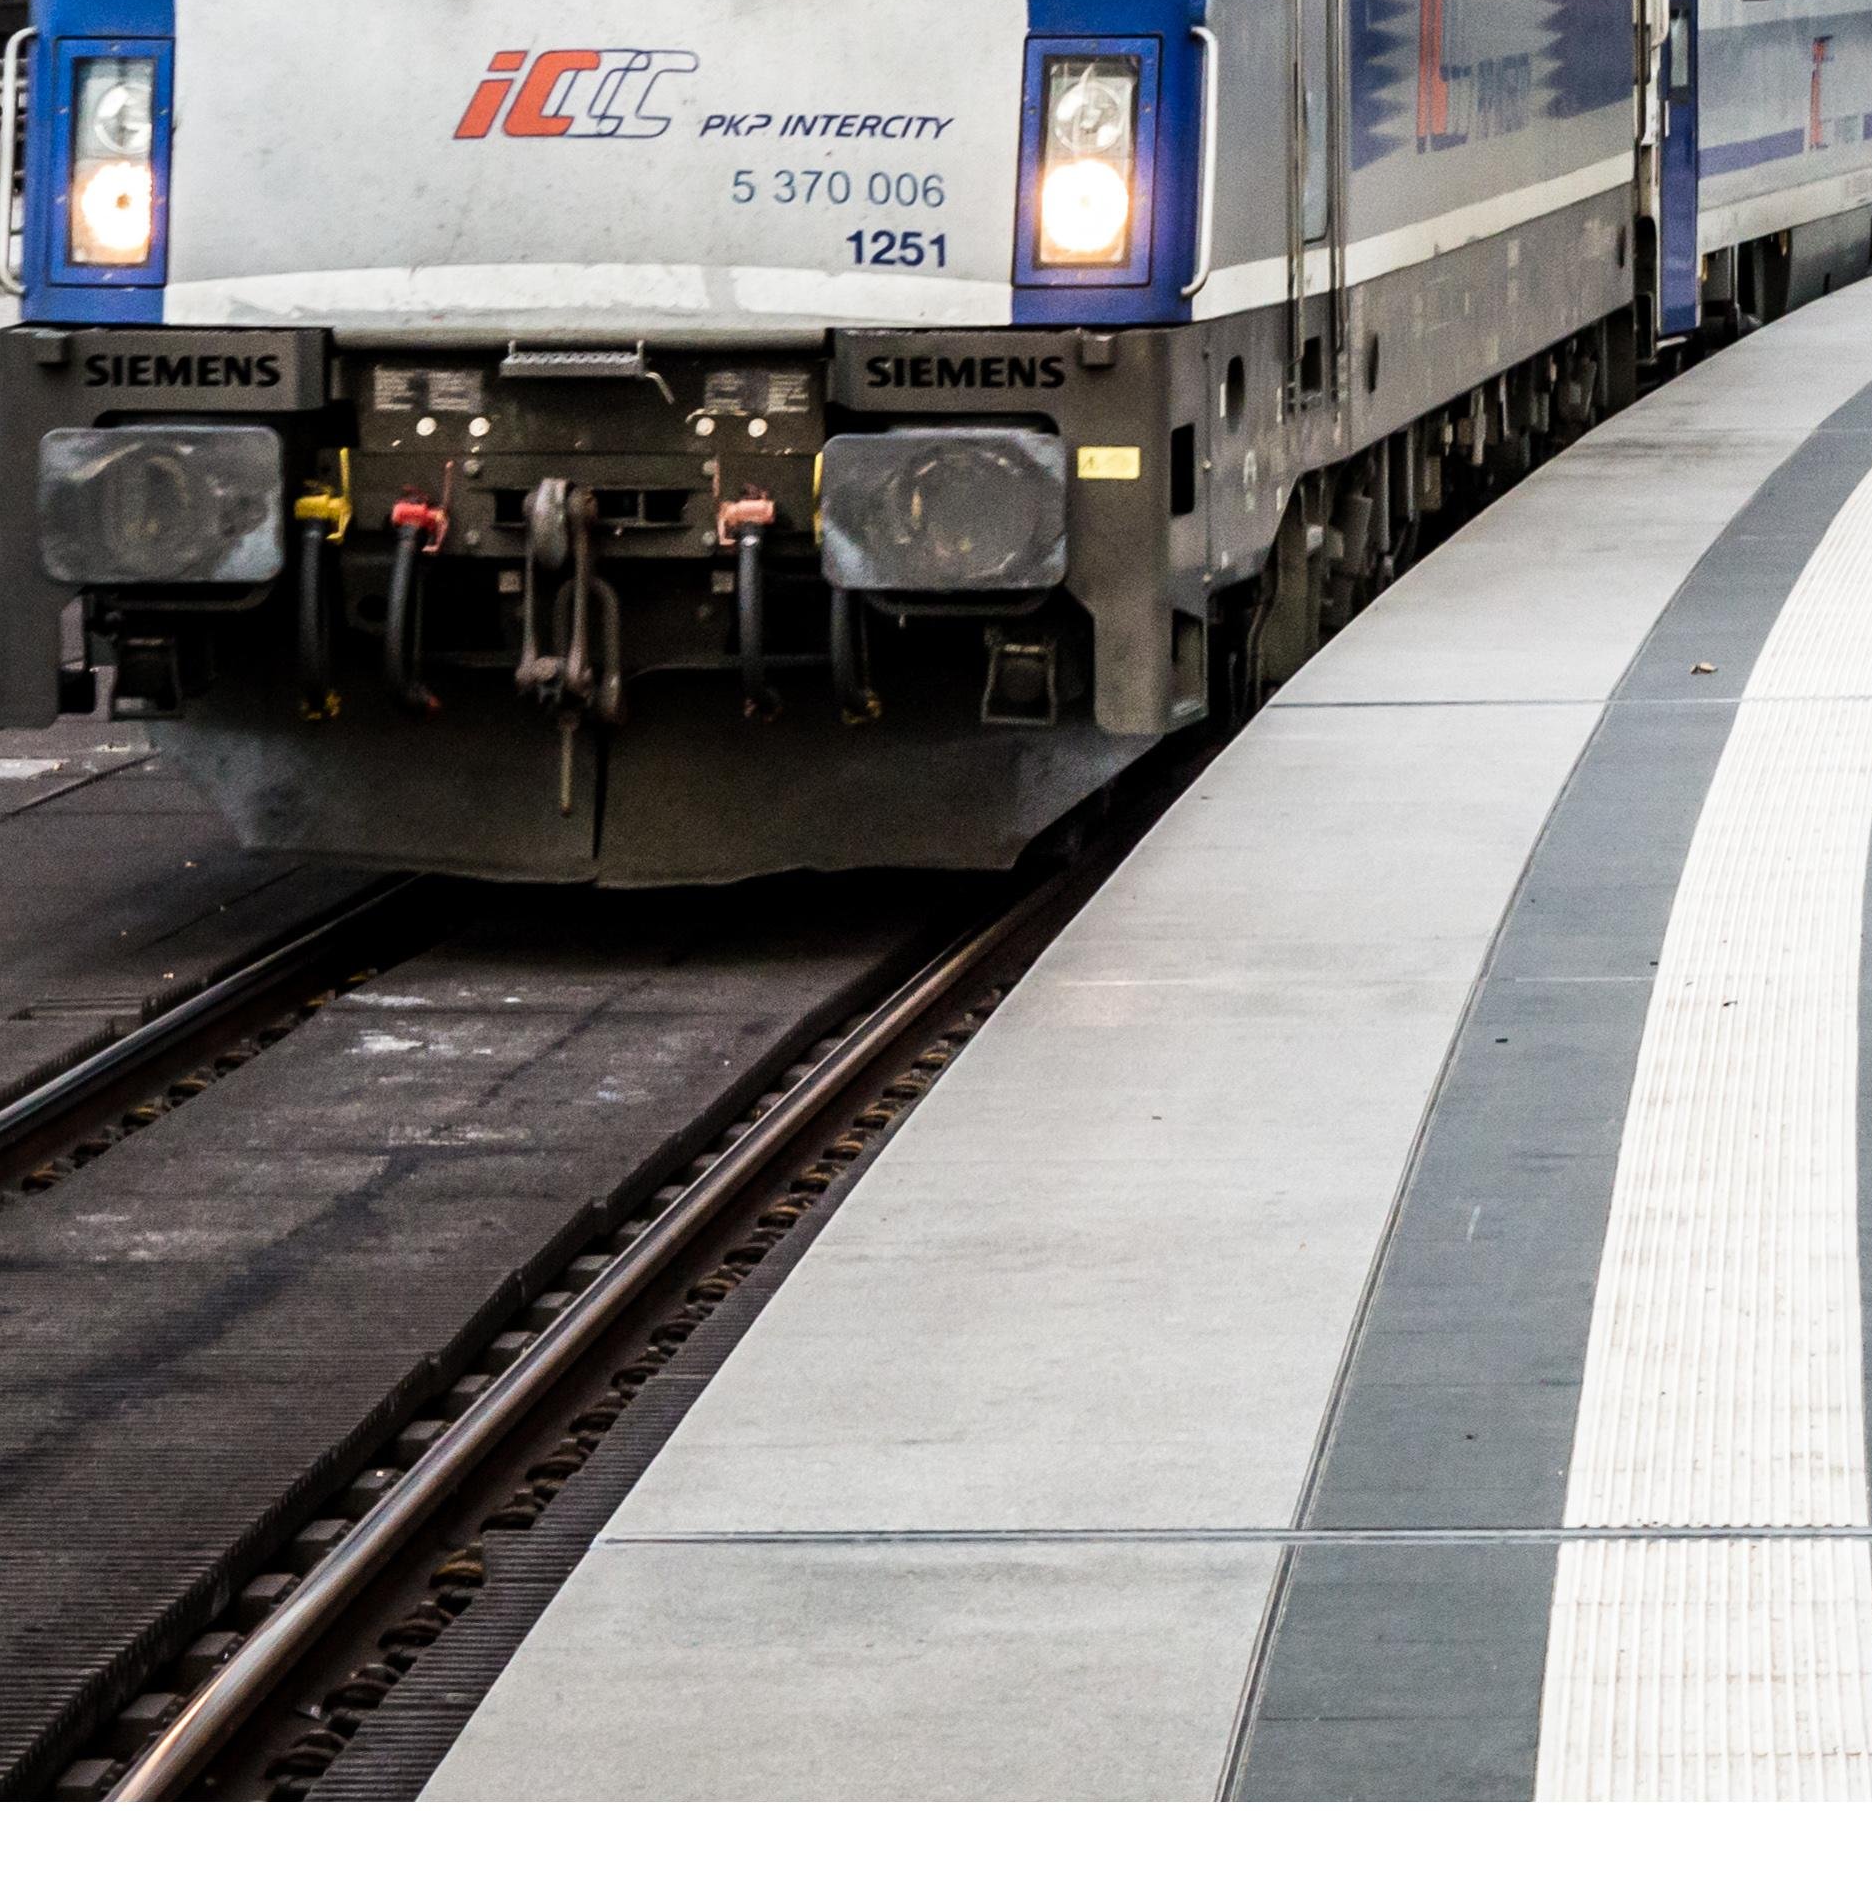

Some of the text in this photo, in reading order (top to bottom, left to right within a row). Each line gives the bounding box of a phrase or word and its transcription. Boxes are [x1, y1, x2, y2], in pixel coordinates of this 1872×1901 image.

[700, 113, 954, 139] PKP INTERCITY
[731, 170, 946, 208] 5 370 006
[846, 229, 947, 267] 1251
[84, 354, 281, 388] SIEMENS
[866, 355, 1065, 389] SIEMENS
